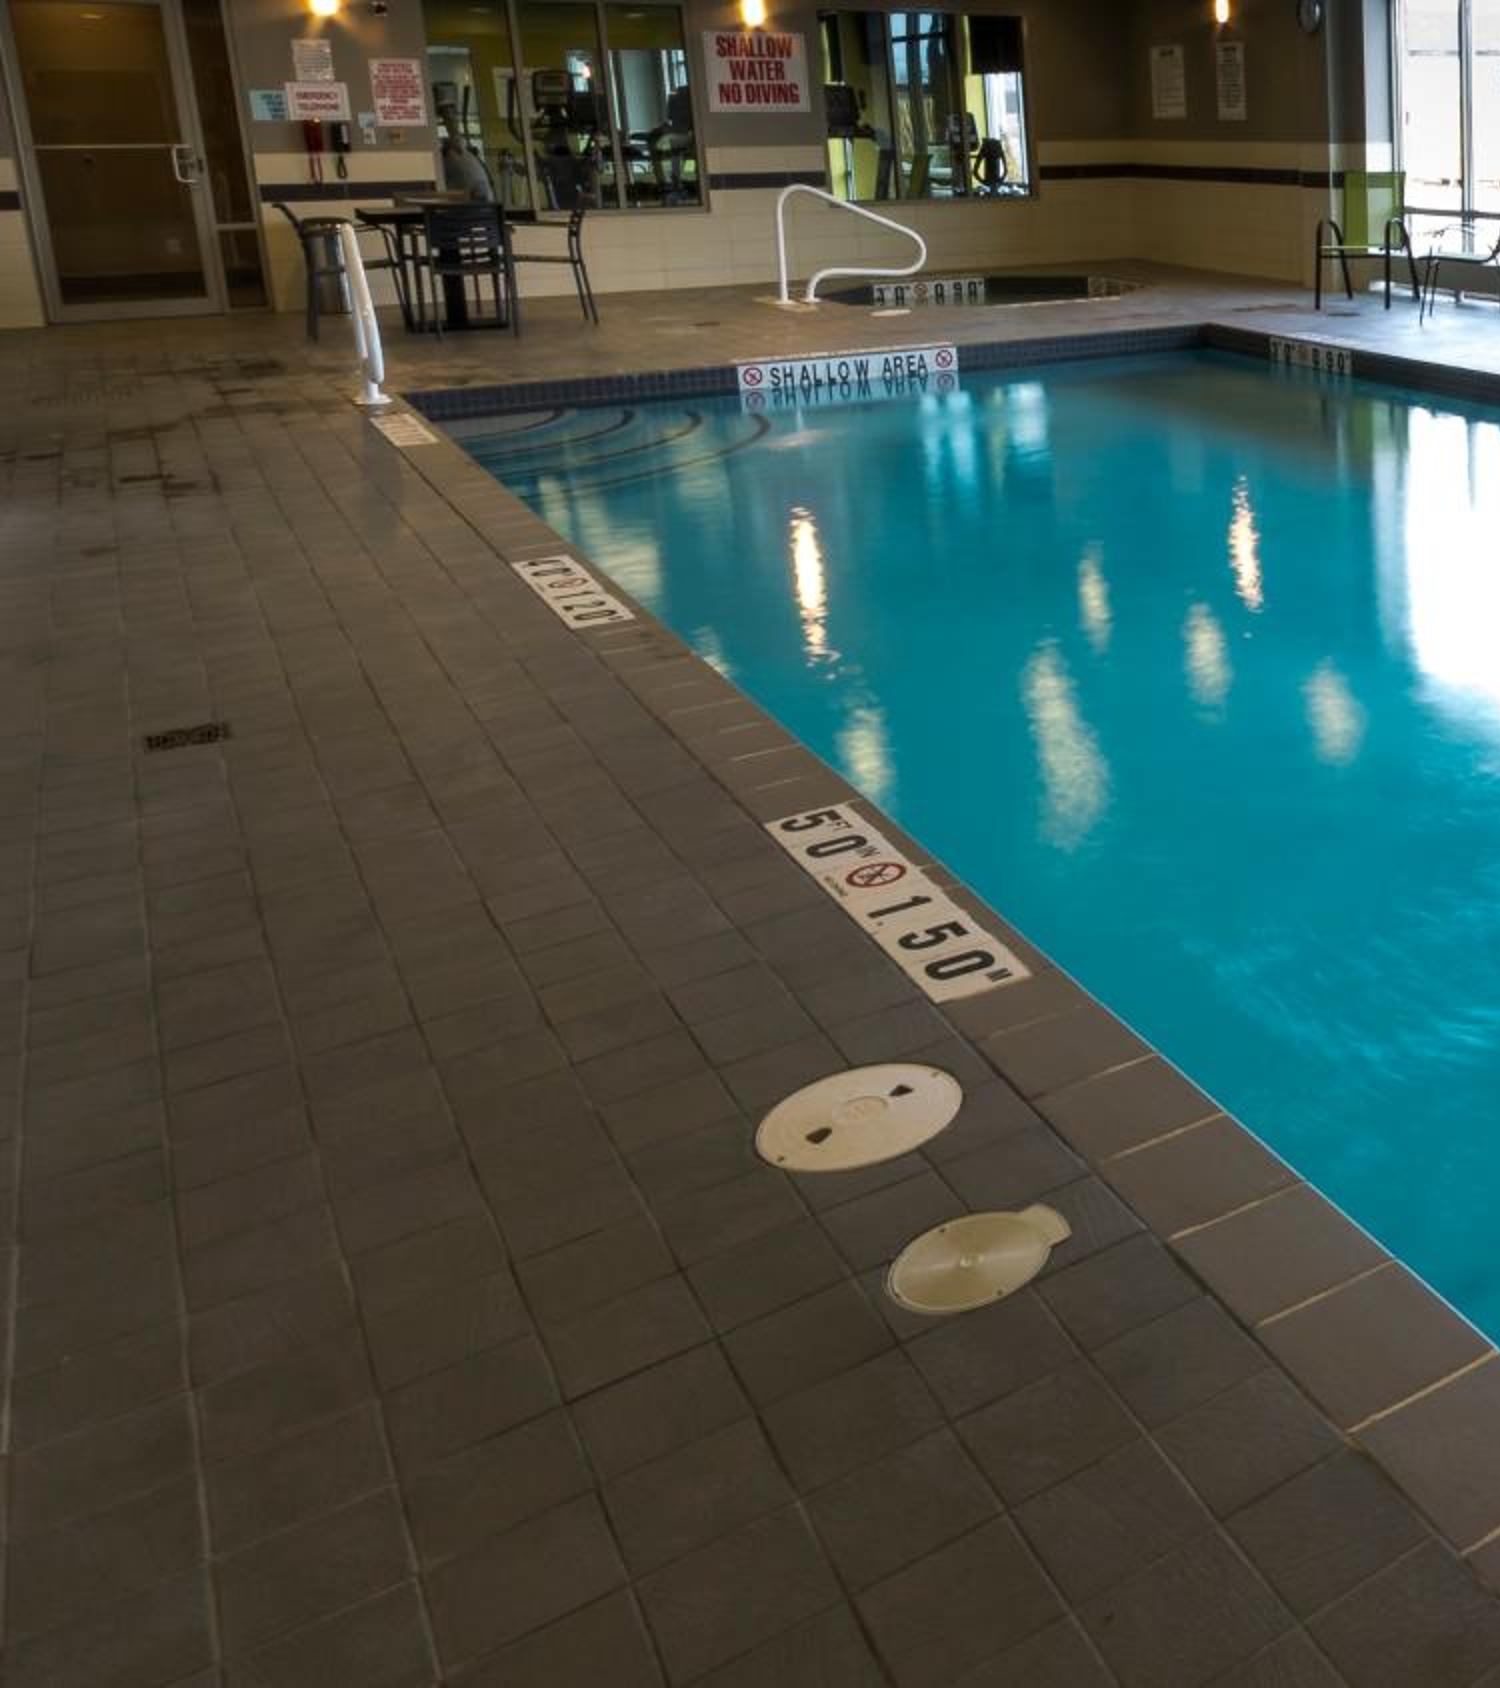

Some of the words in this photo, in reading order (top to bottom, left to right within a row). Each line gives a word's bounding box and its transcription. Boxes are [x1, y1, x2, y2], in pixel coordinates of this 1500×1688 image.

[715, 34, 792, 58] SHALLOW
[729, 60, 785, 80] WATER
[718, 83, 742, 104] NO
[745, 83, 800, 104] DIVING
[769, 359, 870, 388] SHALLOW
[882, 354, 929, 379] AREA
